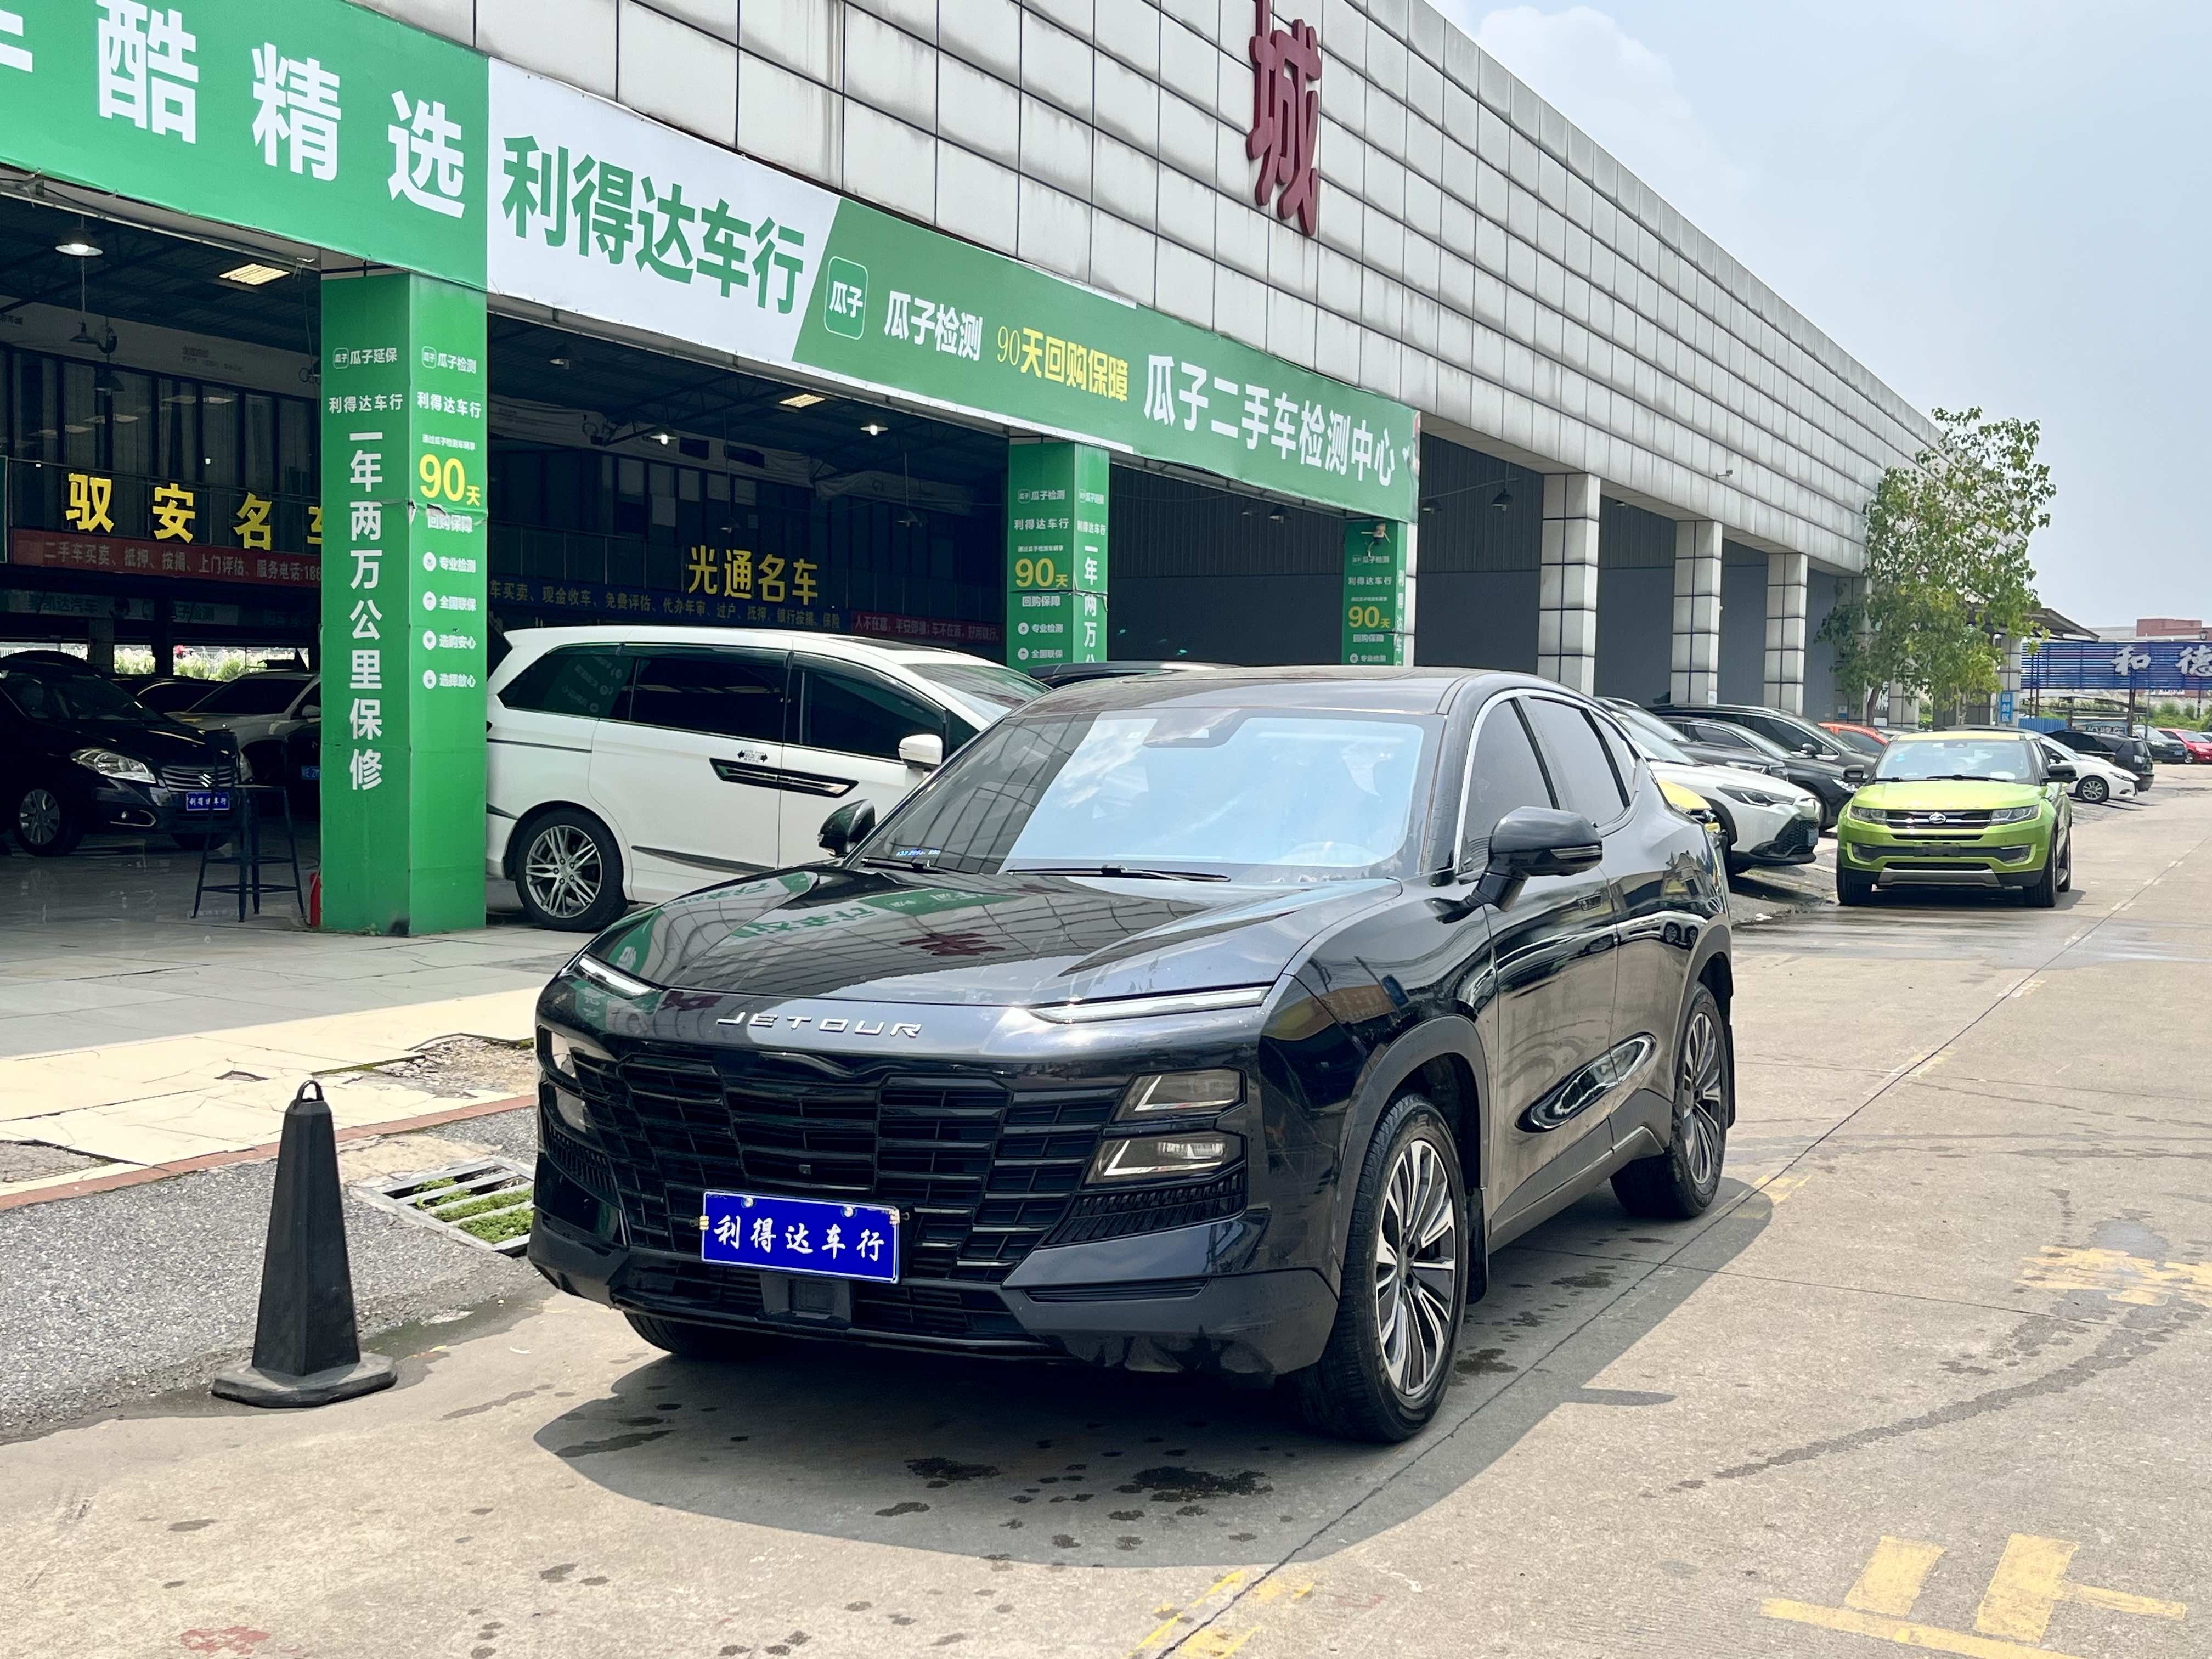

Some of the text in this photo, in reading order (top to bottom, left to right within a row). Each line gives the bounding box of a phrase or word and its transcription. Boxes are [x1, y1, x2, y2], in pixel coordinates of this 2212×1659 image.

[1246, 0, 1321, 236] 城
[502, 136, 805, 314] 利得达车行
[350, 347, 398, 364] 瓜子延保
[437, 353, 477, 374] 瓜子检测
[829, 280, 1395, 487] 瓜子 瓜子检测 90天回购保障 瓜子二手车检测中心
[329, 393, 403, 414] 利得达车行
[417, 391, 482, 419] 利得达车行
[419, 454, 481, 507] 90天
[1031, 489, 1065, 501] 瓜子检测
[427, 514, 473, 533] 回购保障
[1014, 518, 1069, 531] 利得达车行
[439, 556, 476, 573] 专业检测
[1015, 557, 1068, 589] 90天
[688, 545, 818, 606] 光通名车
[1348, 576, 1392, 586] 利得达车行
[349, 431, 383, 791] 一年两万公里保修
[439, 596, 477, 612] 全国联保
[1022, 596, 1061, 607] 回购保障
[1348, 605, 1391, 628] 90天
[1031, 623, 1063, 633] 专业检测
[439, 635, 477, 650] 选购安心
[439, 674, 477, 689] 选择放心
[716, 1011, 922, 1038] JETOUR
[713, 1214, 885, 1262] 利得达车行
